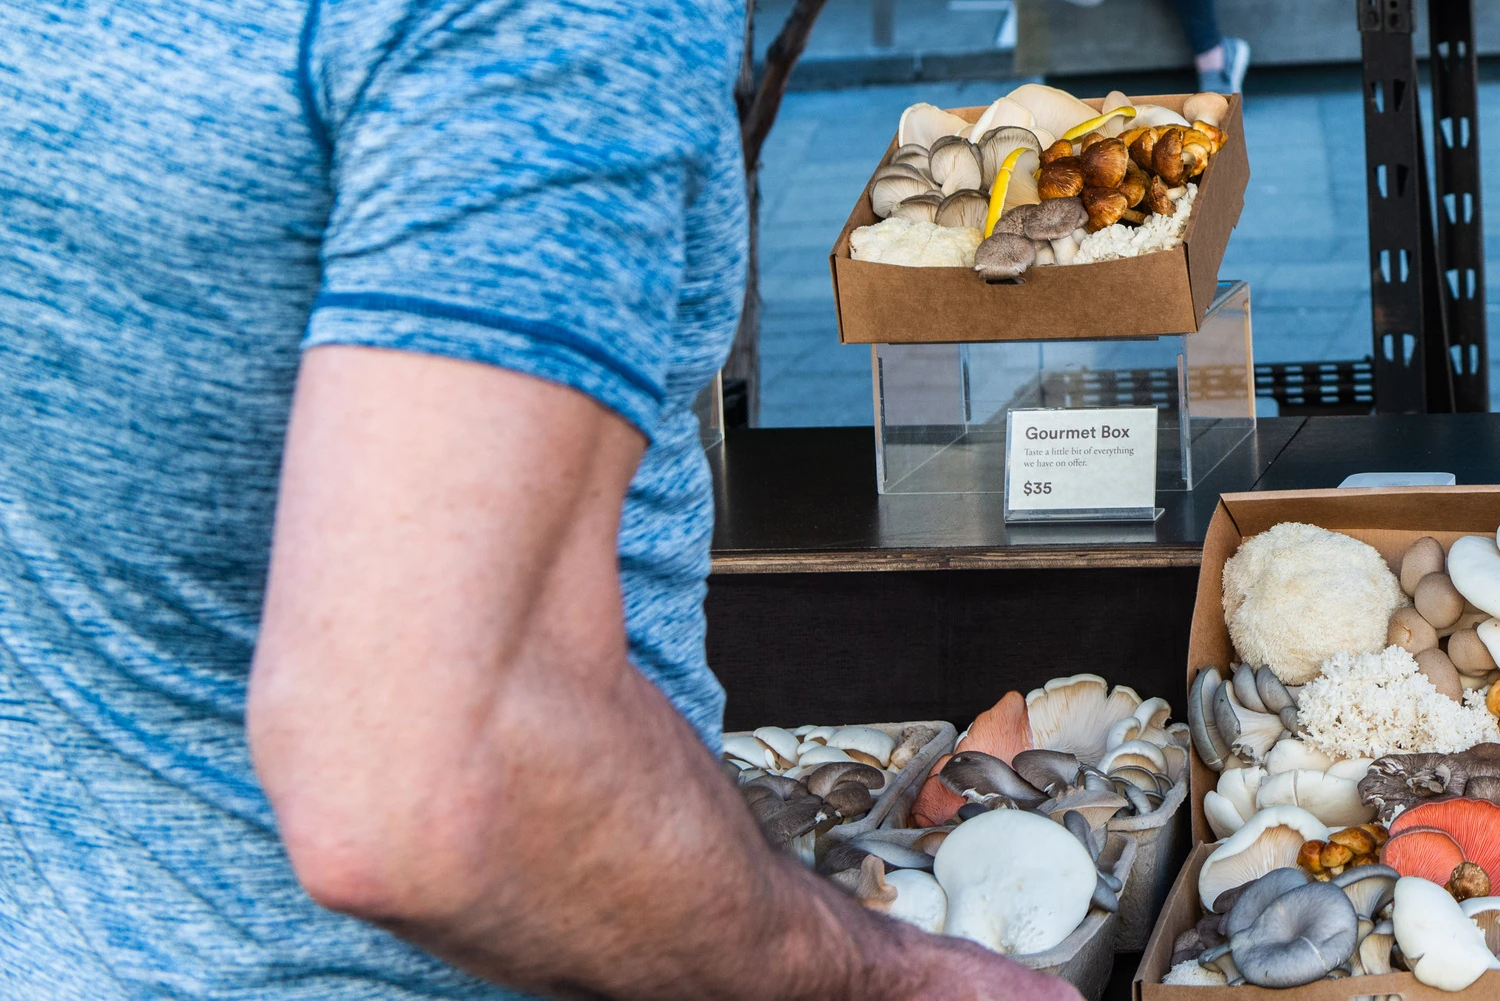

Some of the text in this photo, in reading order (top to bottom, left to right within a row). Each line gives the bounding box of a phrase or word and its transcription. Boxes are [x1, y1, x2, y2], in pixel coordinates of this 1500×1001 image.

[1025, 425, 1130, 440] Gourmet Box
[1024, 448, 1044, 456] Taste
[1051, 447, 1069, 455] little
[1071, 447, 1082, 455] bit
[1084, 447, 1093, 455] of
[1094, 447, 1134, 456] everything
[1037, 459, 1053, 467] have
[1068, 459, 1088, 467] offer.
[1023, 481, 1052, 496] $35
